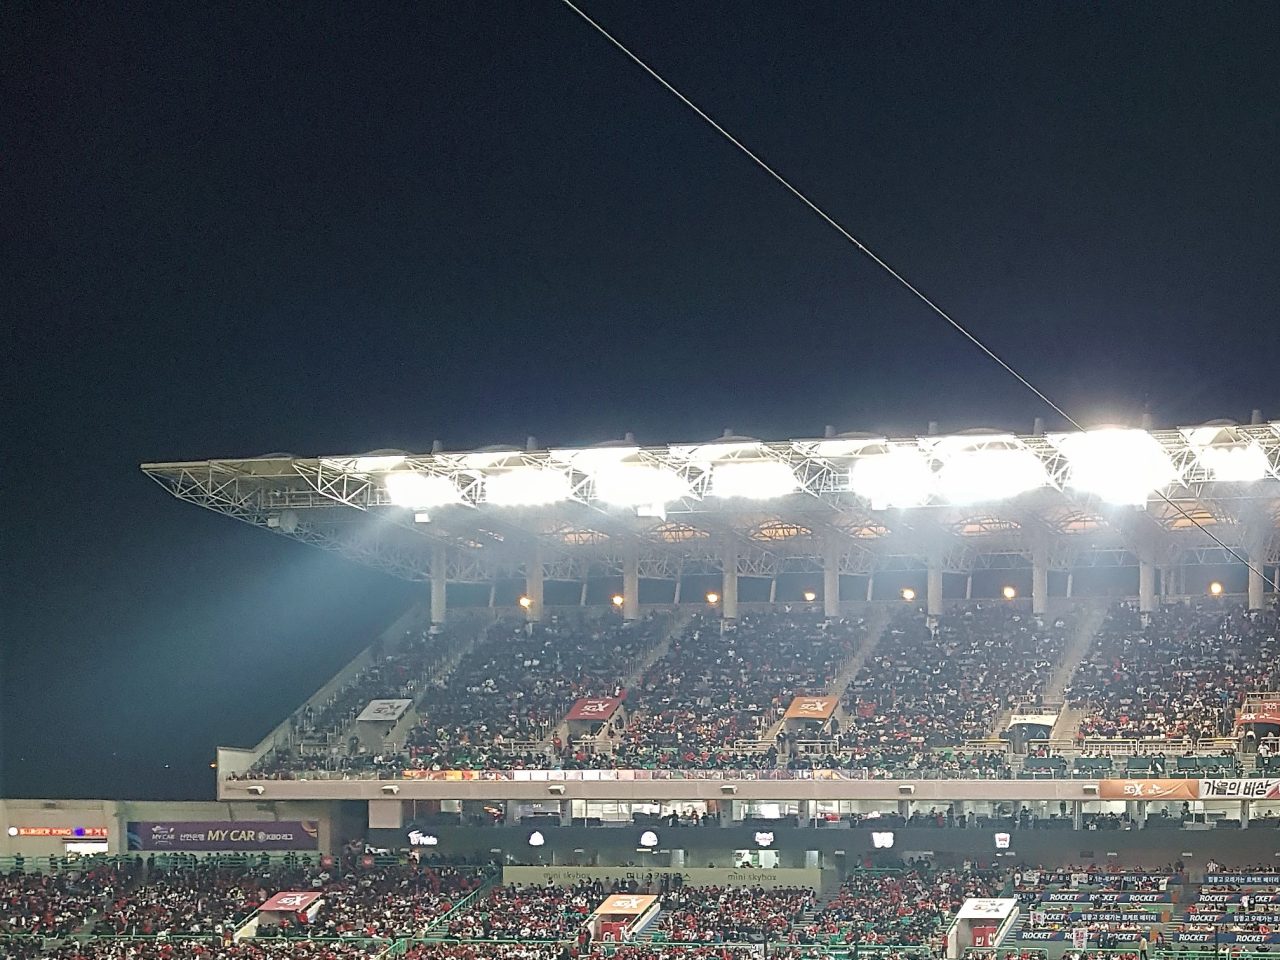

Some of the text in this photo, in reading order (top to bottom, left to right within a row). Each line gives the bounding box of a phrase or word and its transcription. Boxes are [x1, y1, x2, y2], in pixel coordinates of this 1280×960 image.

[1204, 782, 1241, 796] 가을의
[1245, 780, 1272, 796] 비상
[208, 831, 228, 841] MY
[230, 831, 255, 841] CAR
